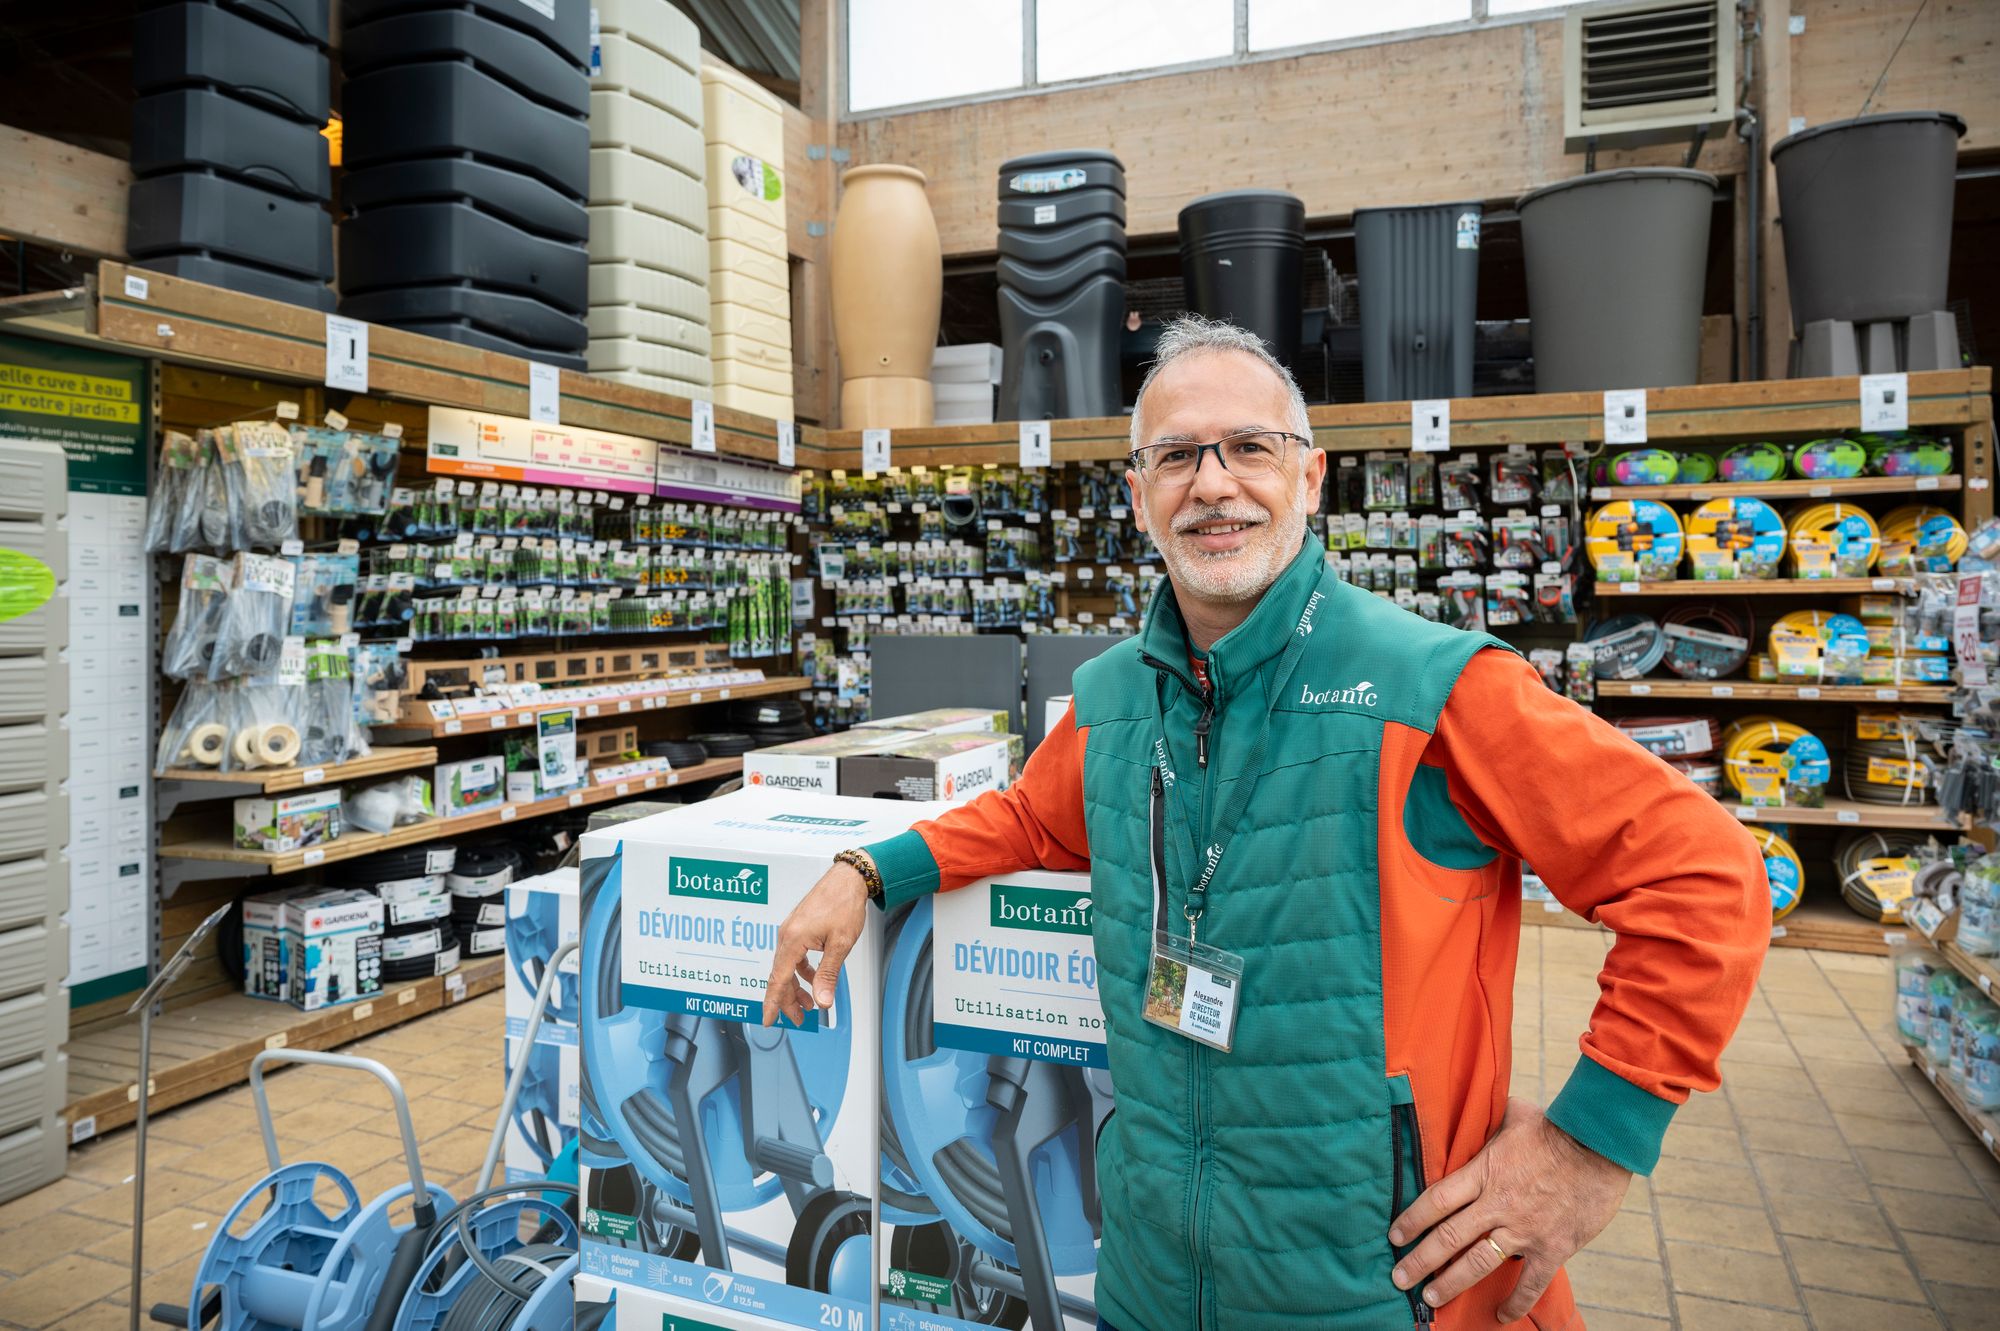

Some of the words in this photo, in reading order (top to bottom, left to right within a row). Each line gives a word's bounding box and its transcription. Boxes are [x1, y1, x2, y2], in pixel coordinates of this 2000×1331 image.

[37, 376, 76, 391] cuve
[81, 376, 91, 393] à
[95, 384, 125, 397] eau
[20, 396, 65, 411] votre
[69, 399, 117, 417] jardin
[121, 406, 130, 419] ?
[1296, 589, 1325, 637] botanic
[1300, 681, 1377, 707] botanic
[1155, 737, 1174, 787] botanic
[765, 774, 822, 788] GARDENA
[956, 766, 993, 793] GARDENA
[1193, 843, 1223, 893] botanic
[675, 866, 762, 896] botanic
[999, 895, 1092, 927] botani
[639, 908, 725, 946] DÉVIDOIR
[639, 961, 731, 985] Utilisation
[955, 940, 1061, 983] DÉVIDOIR
[686, 997, 701, 1012] KIT
[703, 1000, 748, 1018] COMPLET
[1193, 990, 1224, 1007] Alexandre
[955, 998, 1068, 1025] Utilisation
[1189, 1010, 1196, 1020] DE
[1197, 1014, 1221, 1029] MAGASIN
[1192, 1002, 1220, 1019] DIRECTEUR
[1013, 1039, 1031, 1054] KIT
[1034, 1041, 1089, 1062] COMPLET
[611, 1254, 640, 1268] DÉVIDOIR
[611, 1265, 633, 1278] ÉQUIPÉ
[678, 1276, 693, 1287] JETS
[733, 1282, 755, 1296] TUYAU
[916, 1285, 941, 1295] ARROSAGE
[752, 1301, 765, 1310] mm
[820, 1303, 842, 1328] 20
[848, 1309, 863, 1331] M
